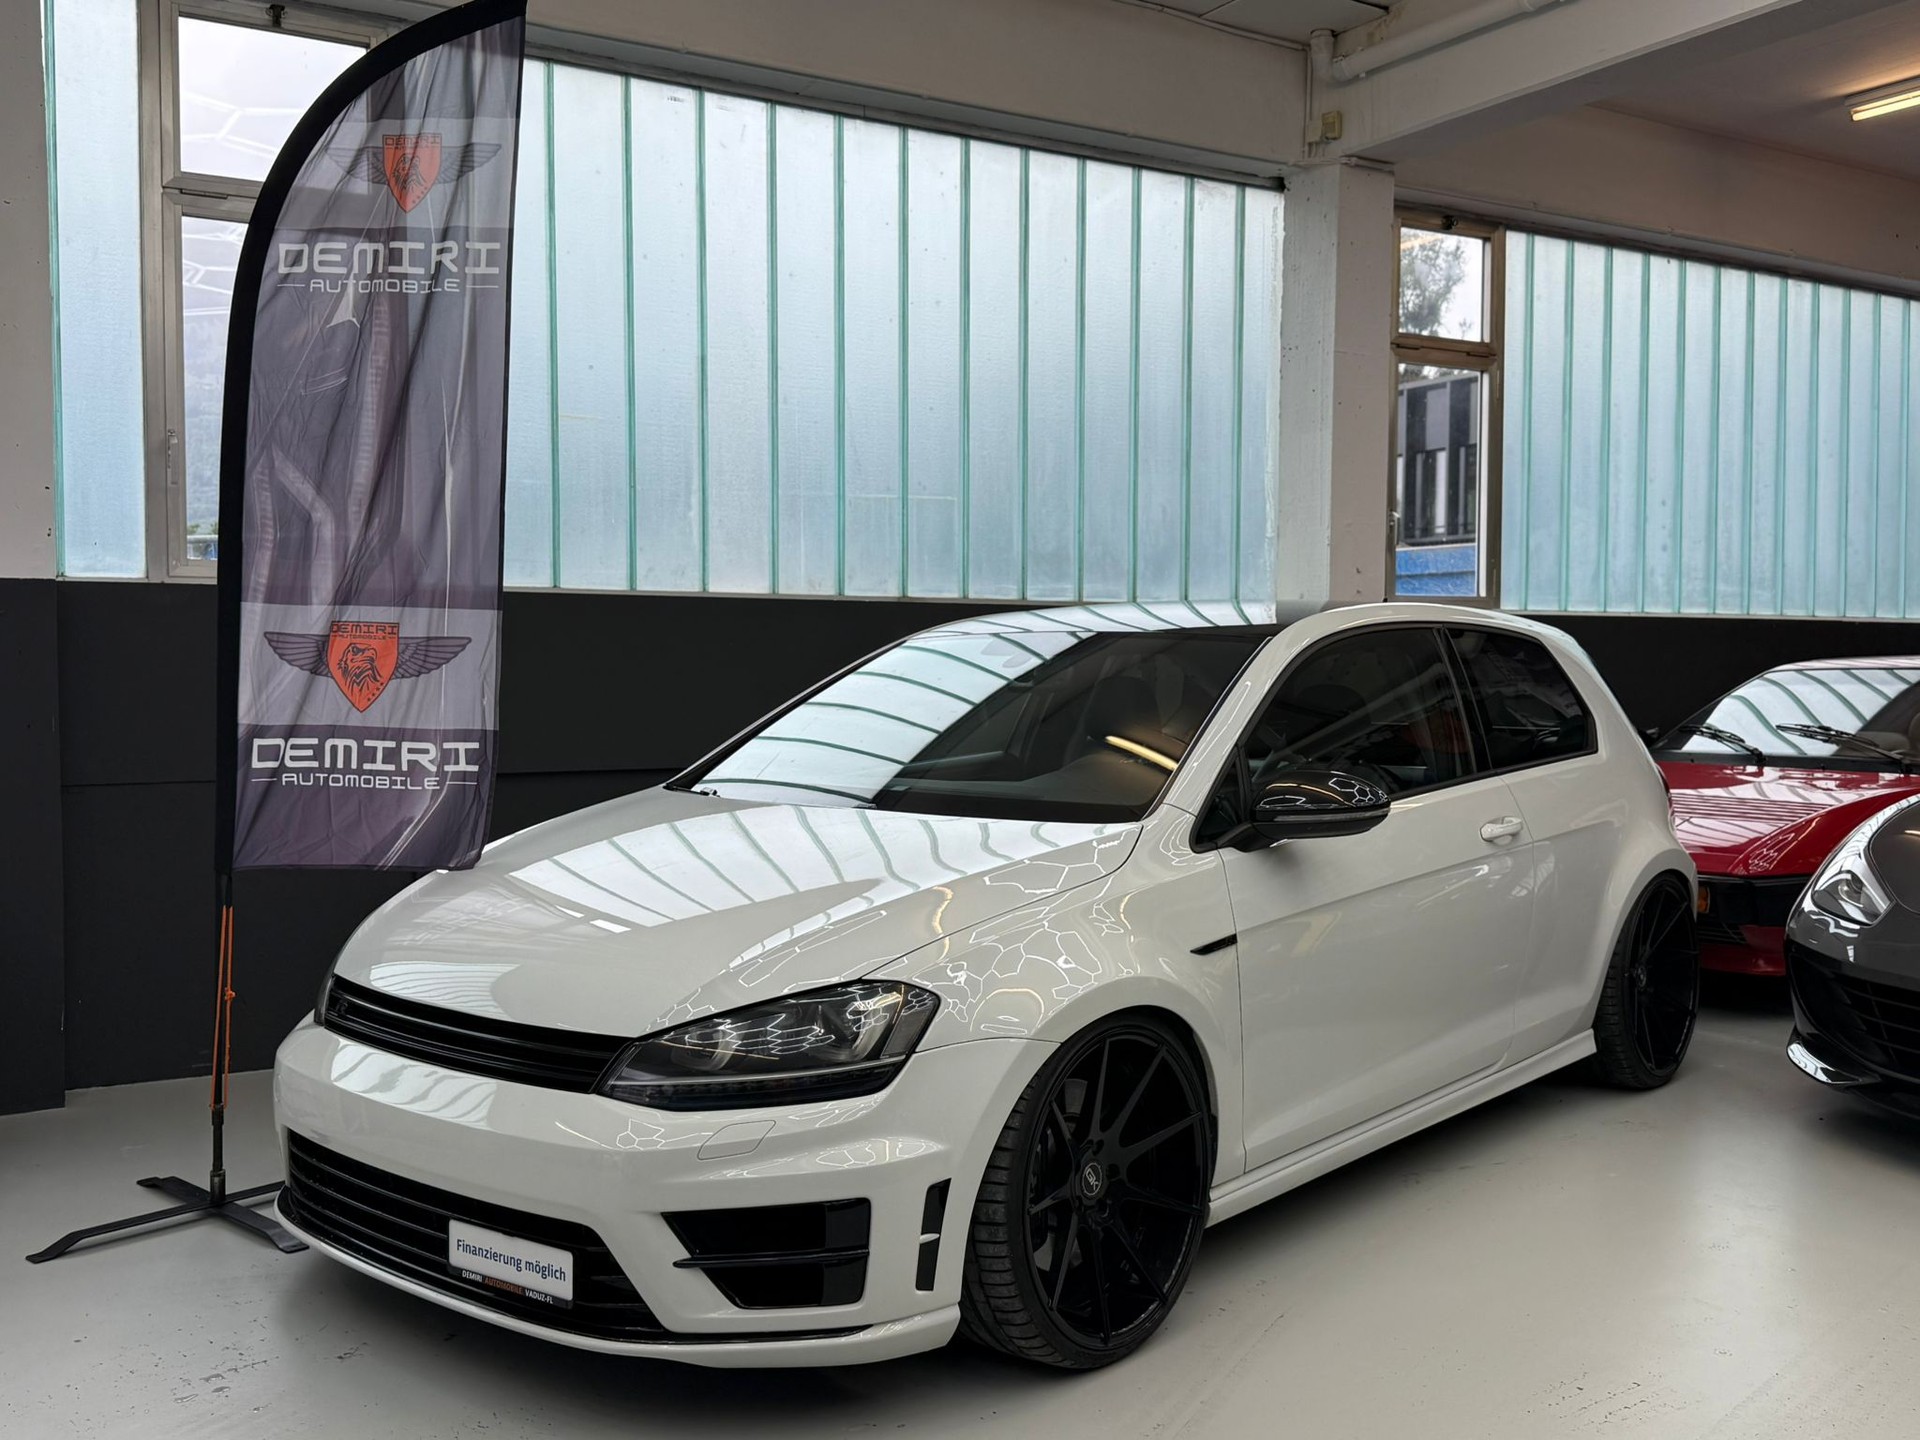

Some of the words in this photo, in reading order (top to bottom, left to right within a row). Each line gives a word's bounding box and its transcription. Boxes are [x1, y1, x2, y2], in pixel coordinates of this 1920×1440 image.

[278, 240, 501, 274] DEMIRI
[309, 278, 460, 293] AUTOMOBILE
[332, 624, 397, 635] DEMIRI
[251, 737, 480, 772] DEMIRI
[282, 773, 440, 790] AUTOMOBILE
[456, 1239, 522, 1272] Finanzierung
[524, 1259, 566, 1282] möglich
[461, 1270, 483, 1282] DEMIRI
[525, 1288, 554, 1304] VADUZ-FL
